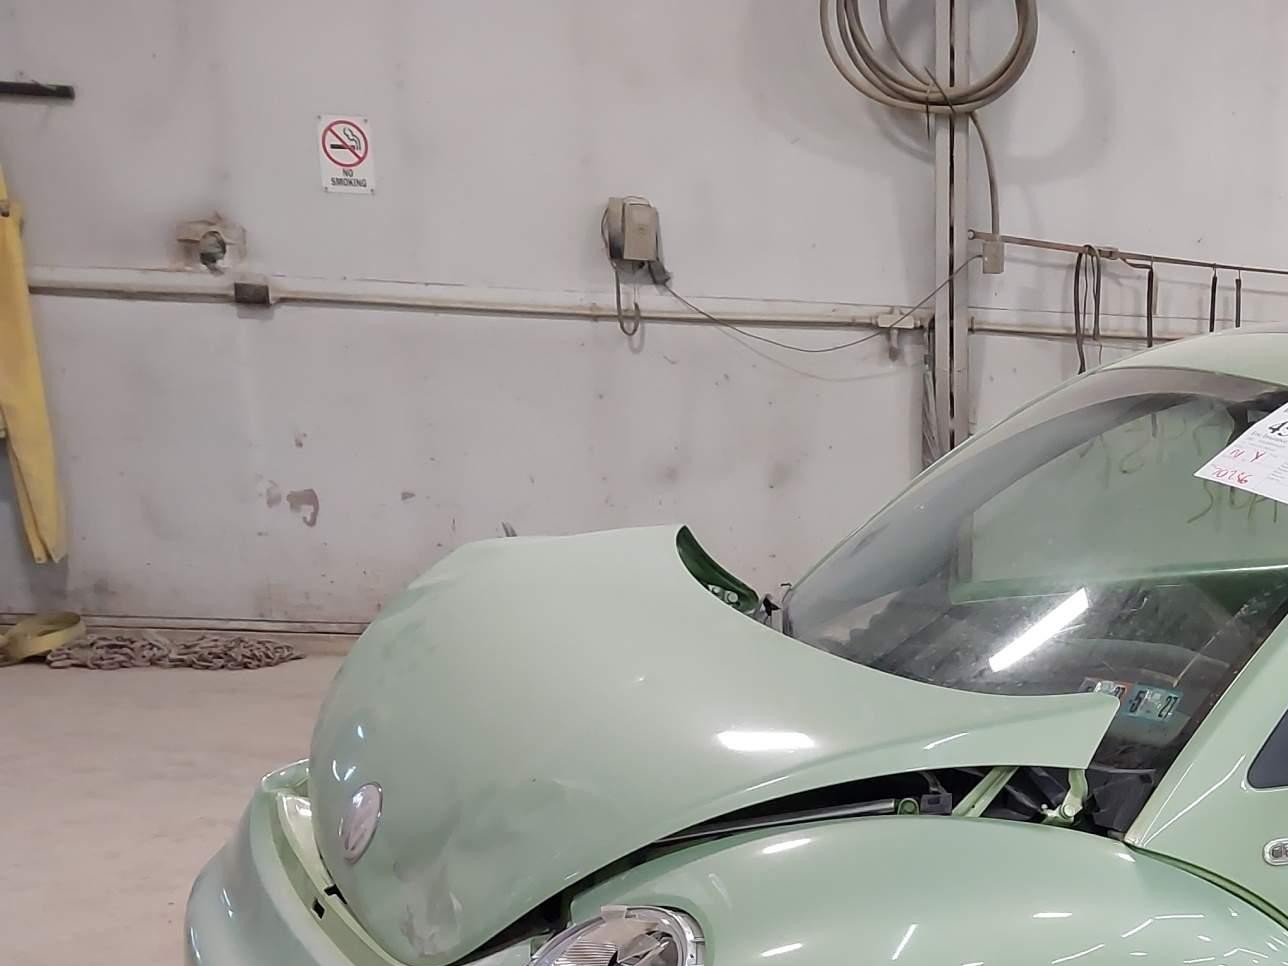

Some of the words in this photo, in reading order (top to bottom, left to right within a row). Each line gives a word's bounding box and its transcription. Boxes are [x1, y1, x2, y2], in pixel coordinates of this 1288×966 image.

[342, 168, 354, 178] NO
[331, 177, 367, 187] SMOKING
[1157, 695, 1179, 719] 27
